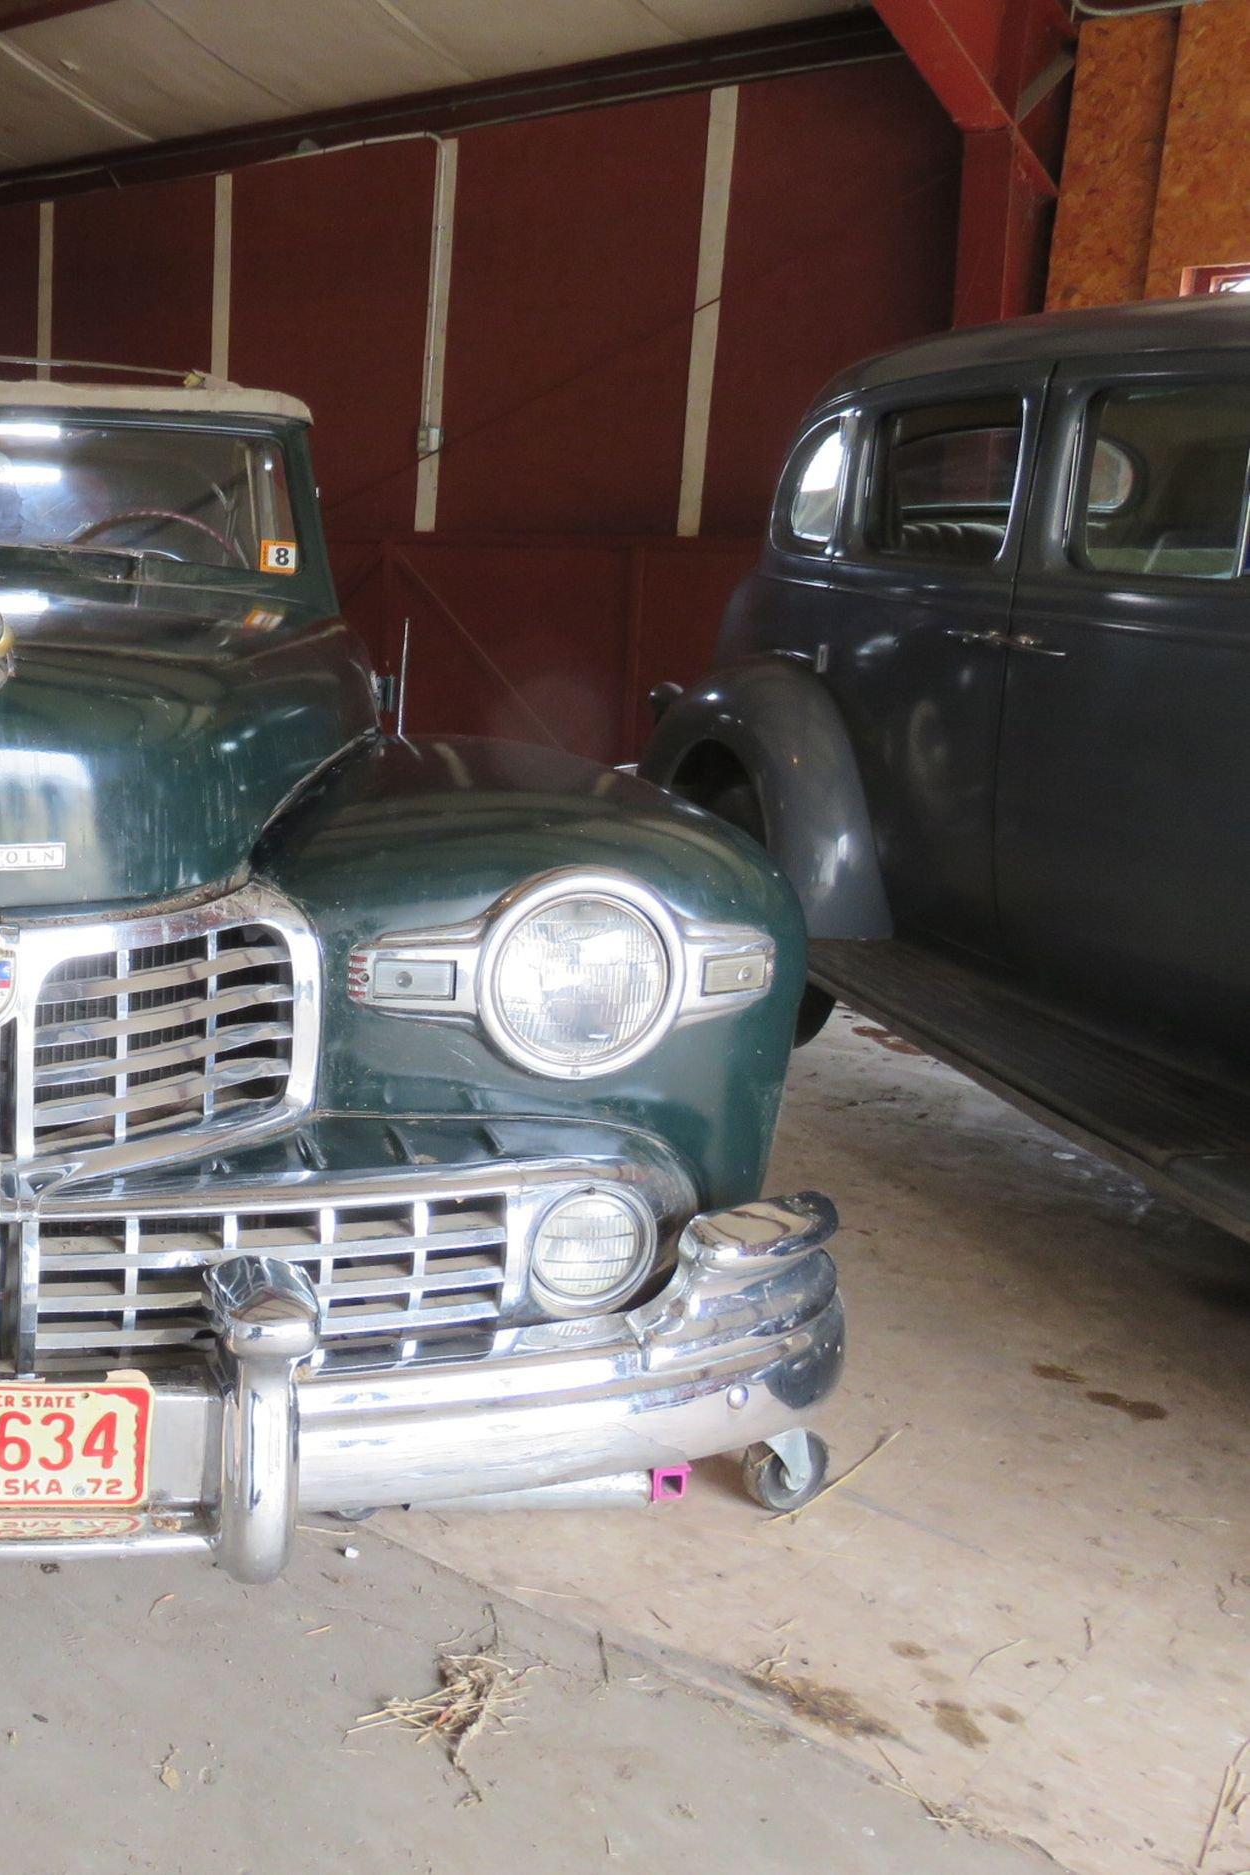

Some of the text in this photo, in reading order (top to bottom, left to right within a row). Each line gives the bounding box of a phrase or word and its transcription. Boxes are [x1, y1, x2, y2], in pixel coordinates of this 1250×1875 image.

[275, 547, 289, 566] 8
[21, 1395, 75, 1409] STATE
[86, 1478, 123, 1495] 72
